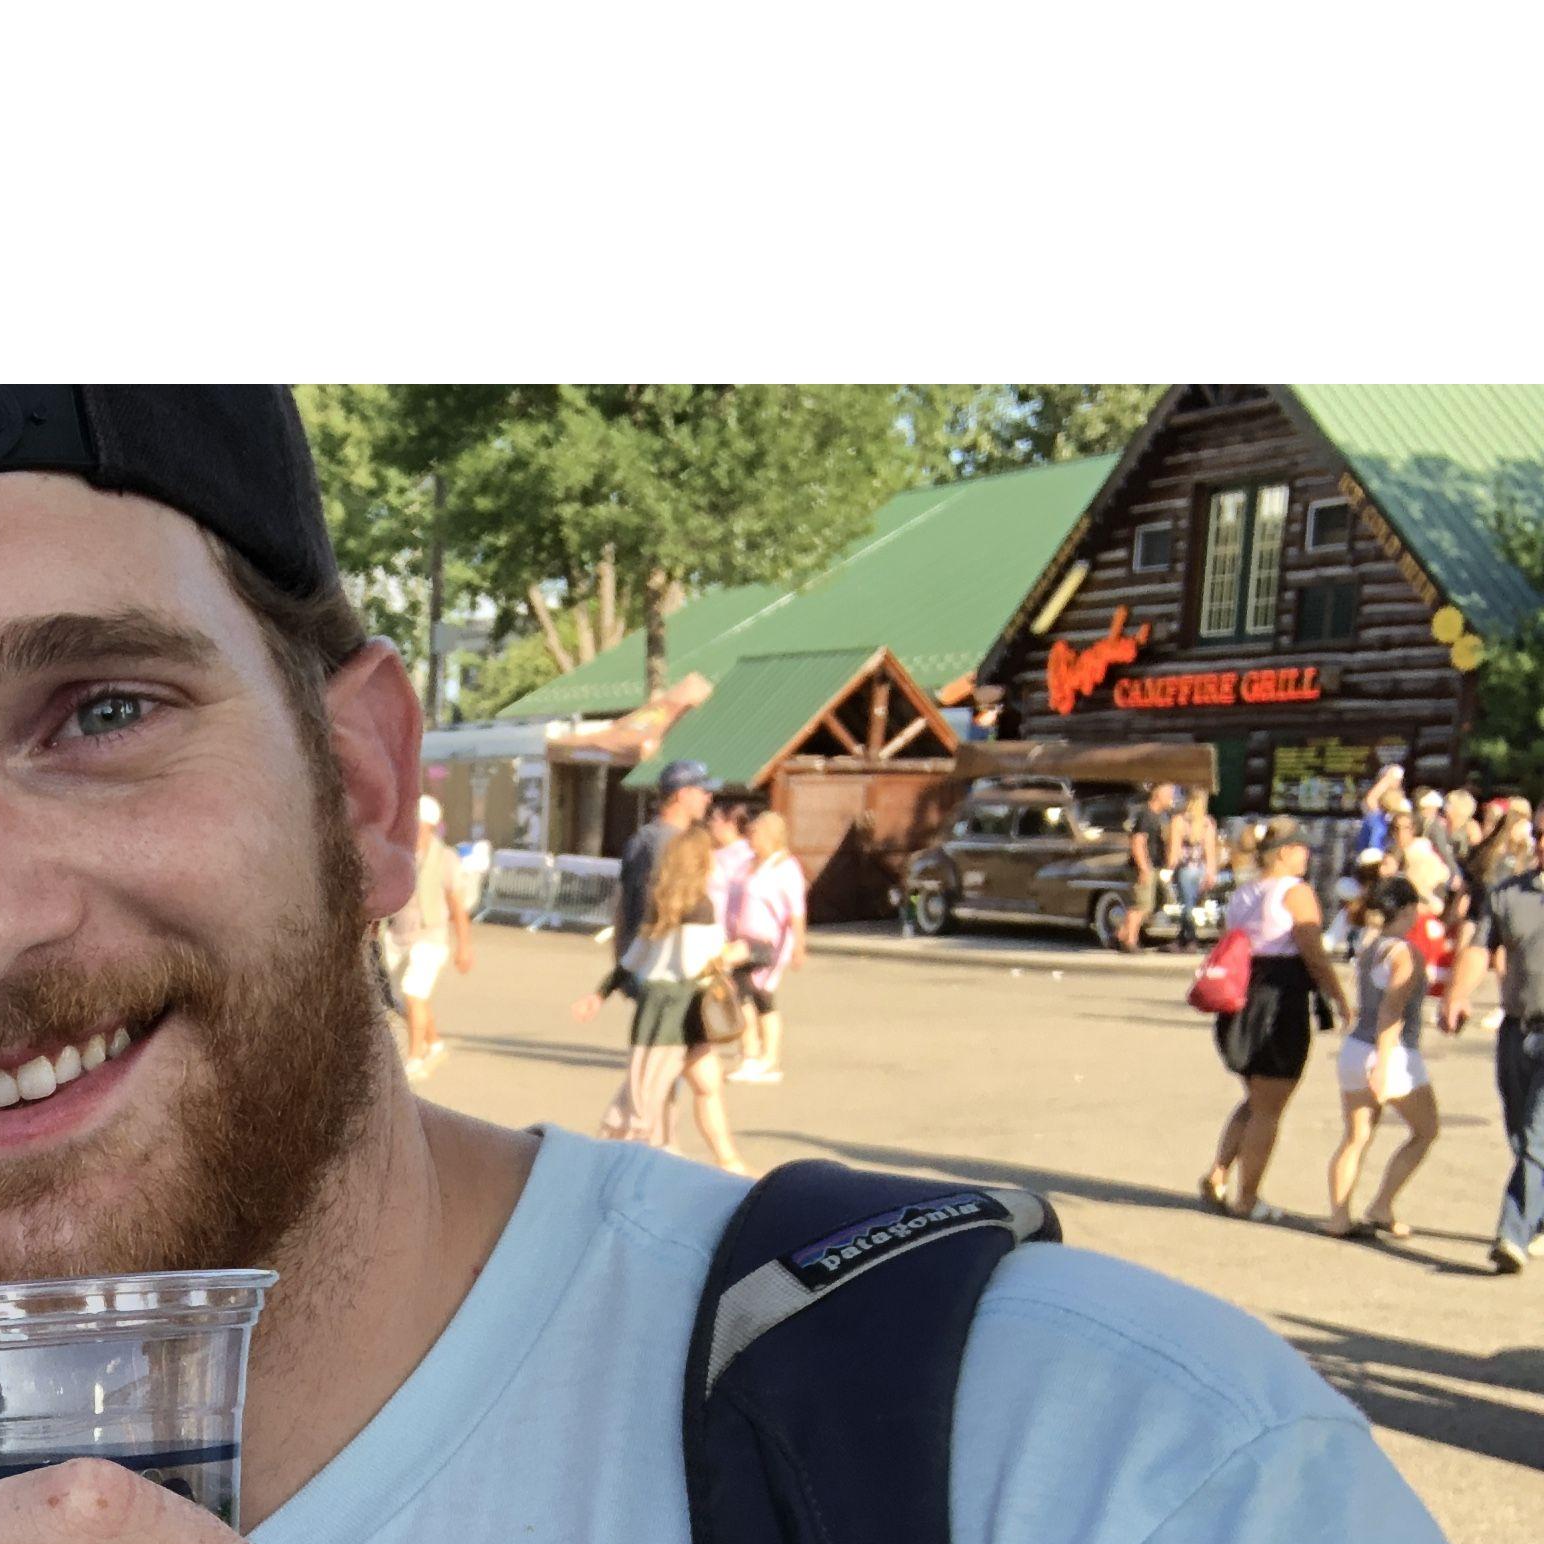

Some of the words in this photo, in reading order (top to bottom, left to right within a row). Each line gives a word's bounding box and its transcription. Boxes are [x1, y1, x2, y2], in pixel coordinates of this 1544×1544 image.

[1114, 671, 1239, 709] CAMPFIRE
[1241, 666, 1321, 704] GRILL
[821, 1202, 980, 1271] patagonia
